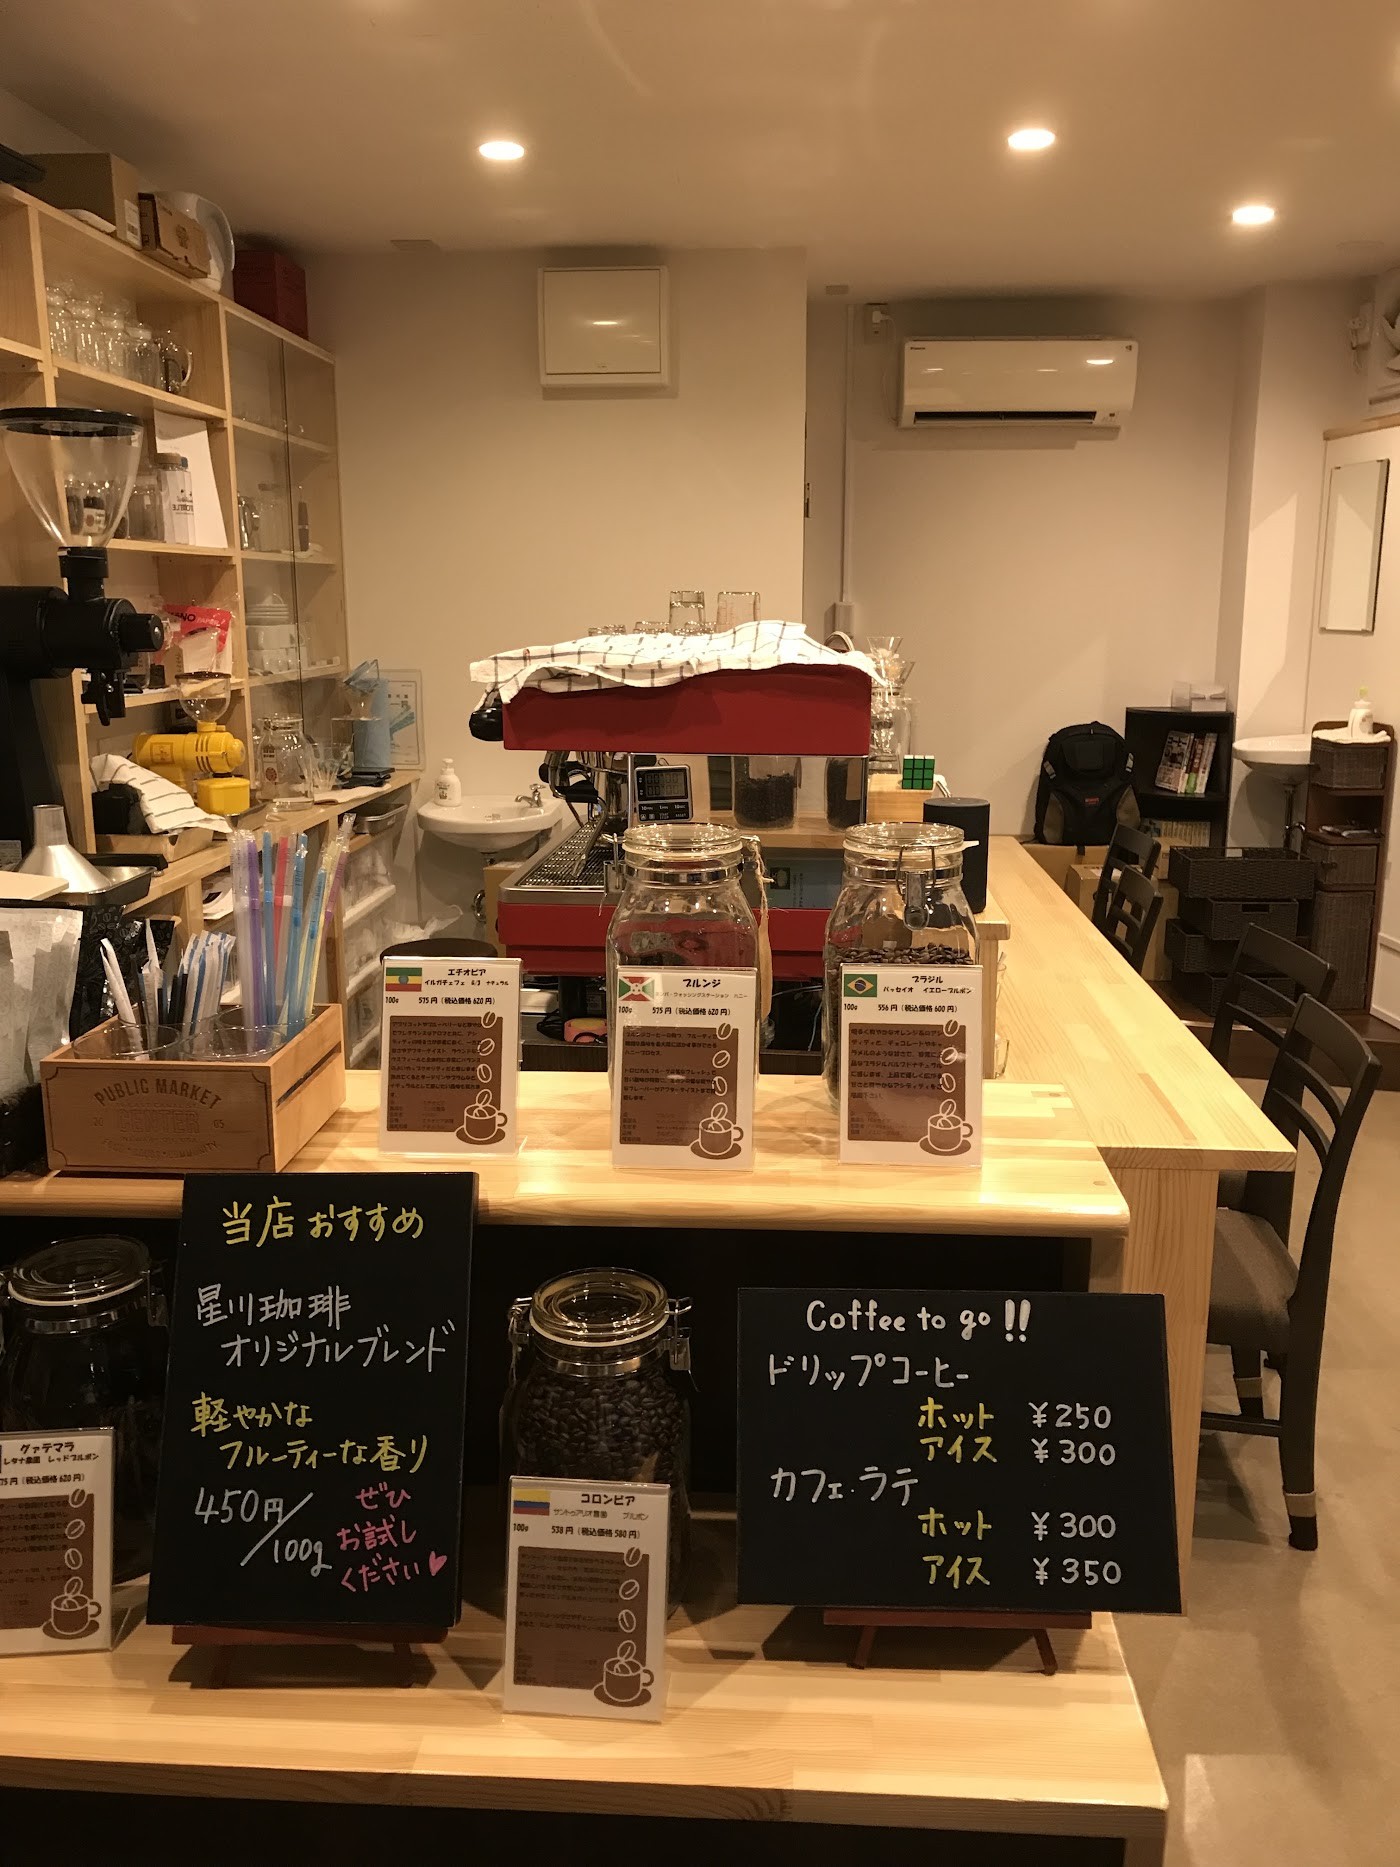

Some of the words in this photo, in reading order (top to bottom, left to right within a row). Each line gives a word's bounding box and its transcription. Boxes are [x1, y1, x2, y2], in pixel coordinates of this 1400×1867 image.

[447, 968, 487, 977] エチオピア
[682, 978, 721, 988] ブルンジ
[911, 975, 944, 984] ブラジル
[385, 996, 400, 1004] 100g
[618, 1005, 633, 1014] 100g
[843, 1003, 858, 1011] 100g
[93, 1078, 149, 1106] PUBLIC
[156, 1078, 222, 1109] MARKET
[119, 1108, 200, 1134] CENTER
[197, 1283, 351, 1330] 星川珈琲
[806, 1299, 906, 1332] Coffee
[917, 1306, 946, 1331] to
[959, 1308, 991, 1341] go
[221, 1319, 456, 1373] オリジナルブレンド
[768, 1353, 969, 1390] ドリップコーヒー
[190, 1391, 313, 1437] 軽やかな
[917, 1397, 995, 1429] ホット
[20, 1442, 75, 1455] グァテマラ
[219, 1434, 429, 1473] フルーティーな香り
[919, 1435, 998, 1463] アイス
[355, 1481, 411, 1510] ぜひ
[581, 1493, 636, 1507] コロンビア
[770, 1466, 919, 1507] カフェ・ラテ
[513, 1522, 529, 1533] 100g
[622, 1512, 649, 1521] ブルボン
[917, 1507, 993, 1540] ホット
[336, 1514, 417, 1551] お試し
[340, 1553, 420, 1593] ください
[922, 1555, 991, 1590] アイス
